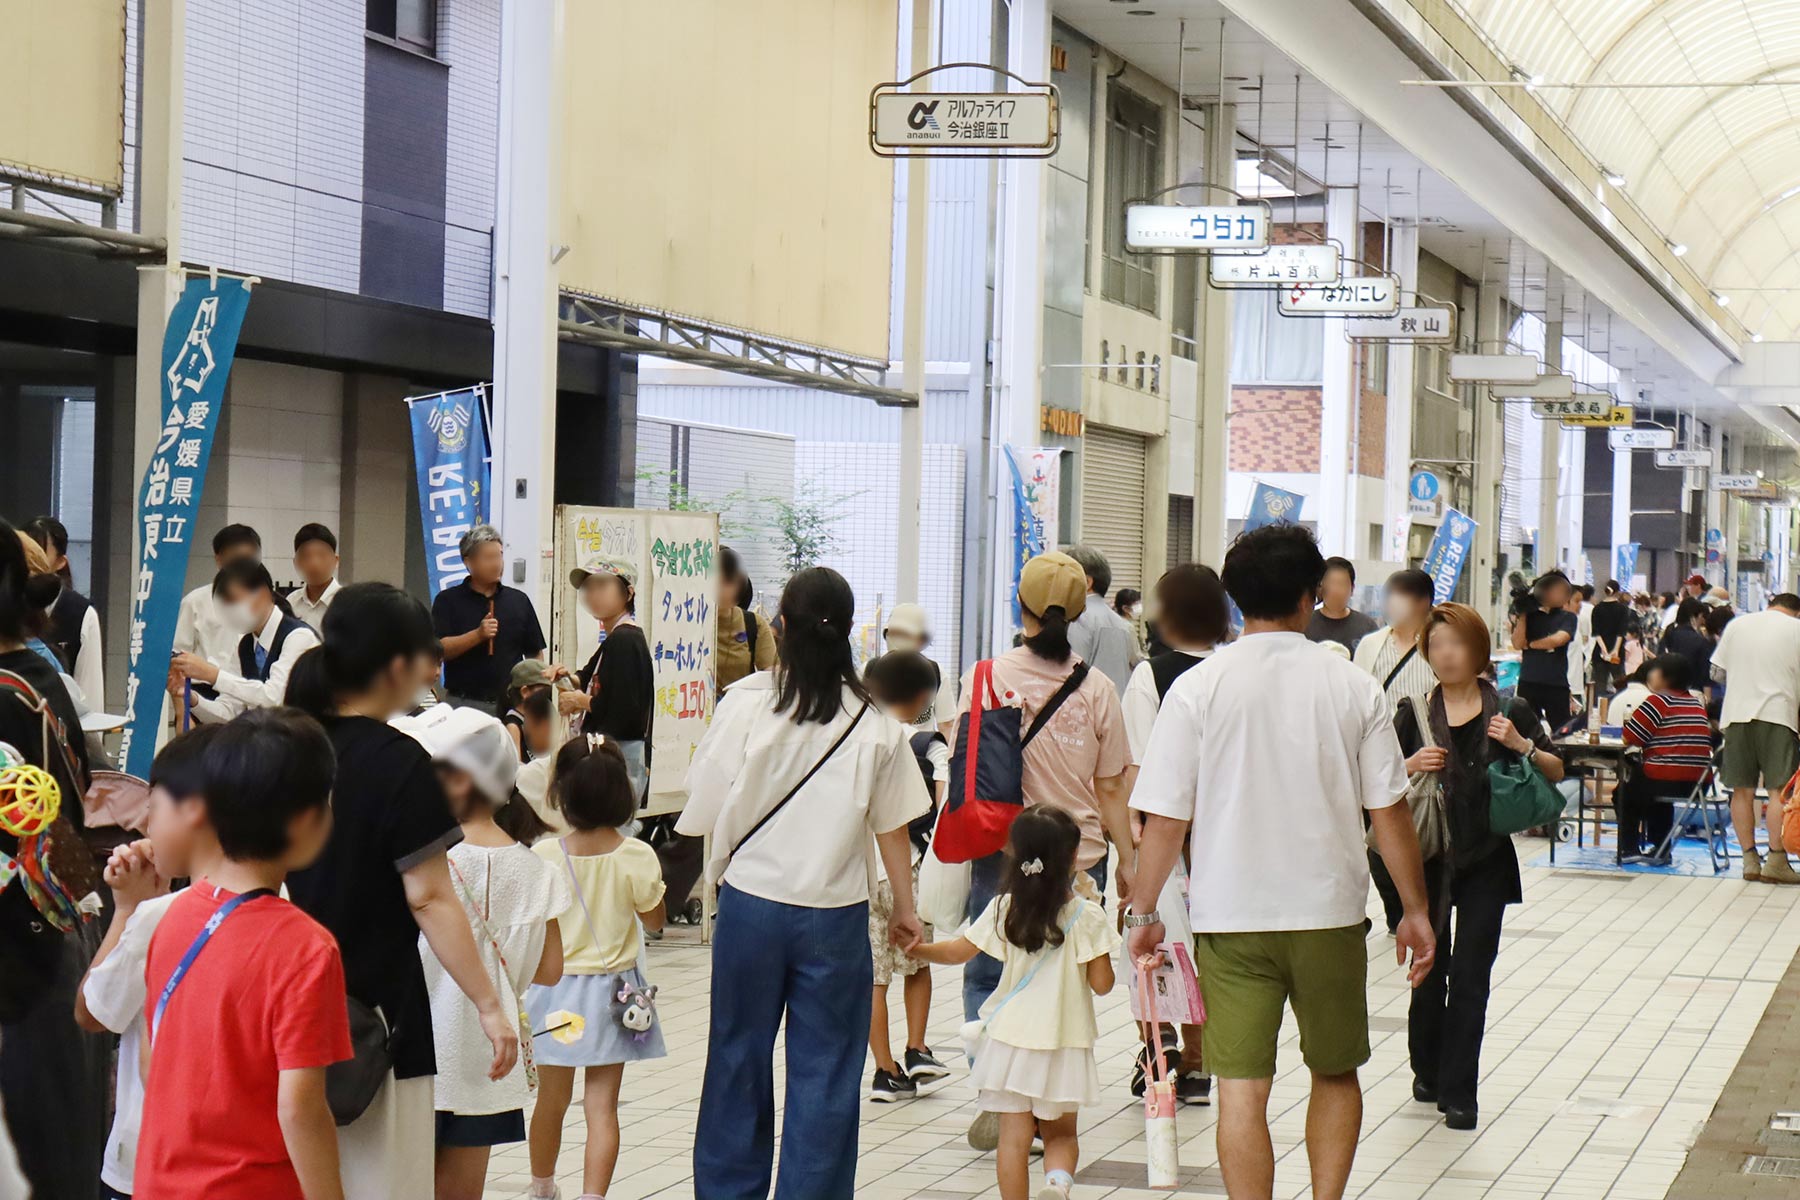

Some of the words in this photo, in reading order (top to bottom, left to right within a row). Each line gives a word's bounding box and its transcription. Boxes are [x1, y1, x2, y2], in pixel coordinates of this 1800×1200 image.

[947, 100, 1016, 118] アルファライフ
[947, 121, 1009, 139] 今治銀座Ⅱ
[1136, 230, 1190, 238] TEXTILE
[1190, 214, 1255, 240] ウダカ
[1321, 285, 1387, 302] なかにし
[1400, 318, 1439, 333] 秋山
[1543, 401, 1600, 414] 寺尾薬局
[162, 401, 210, 543] 愛媛県立
[662, 590, 708, 623] タッセル
[654, 637, 709, 673] キーホルダー
